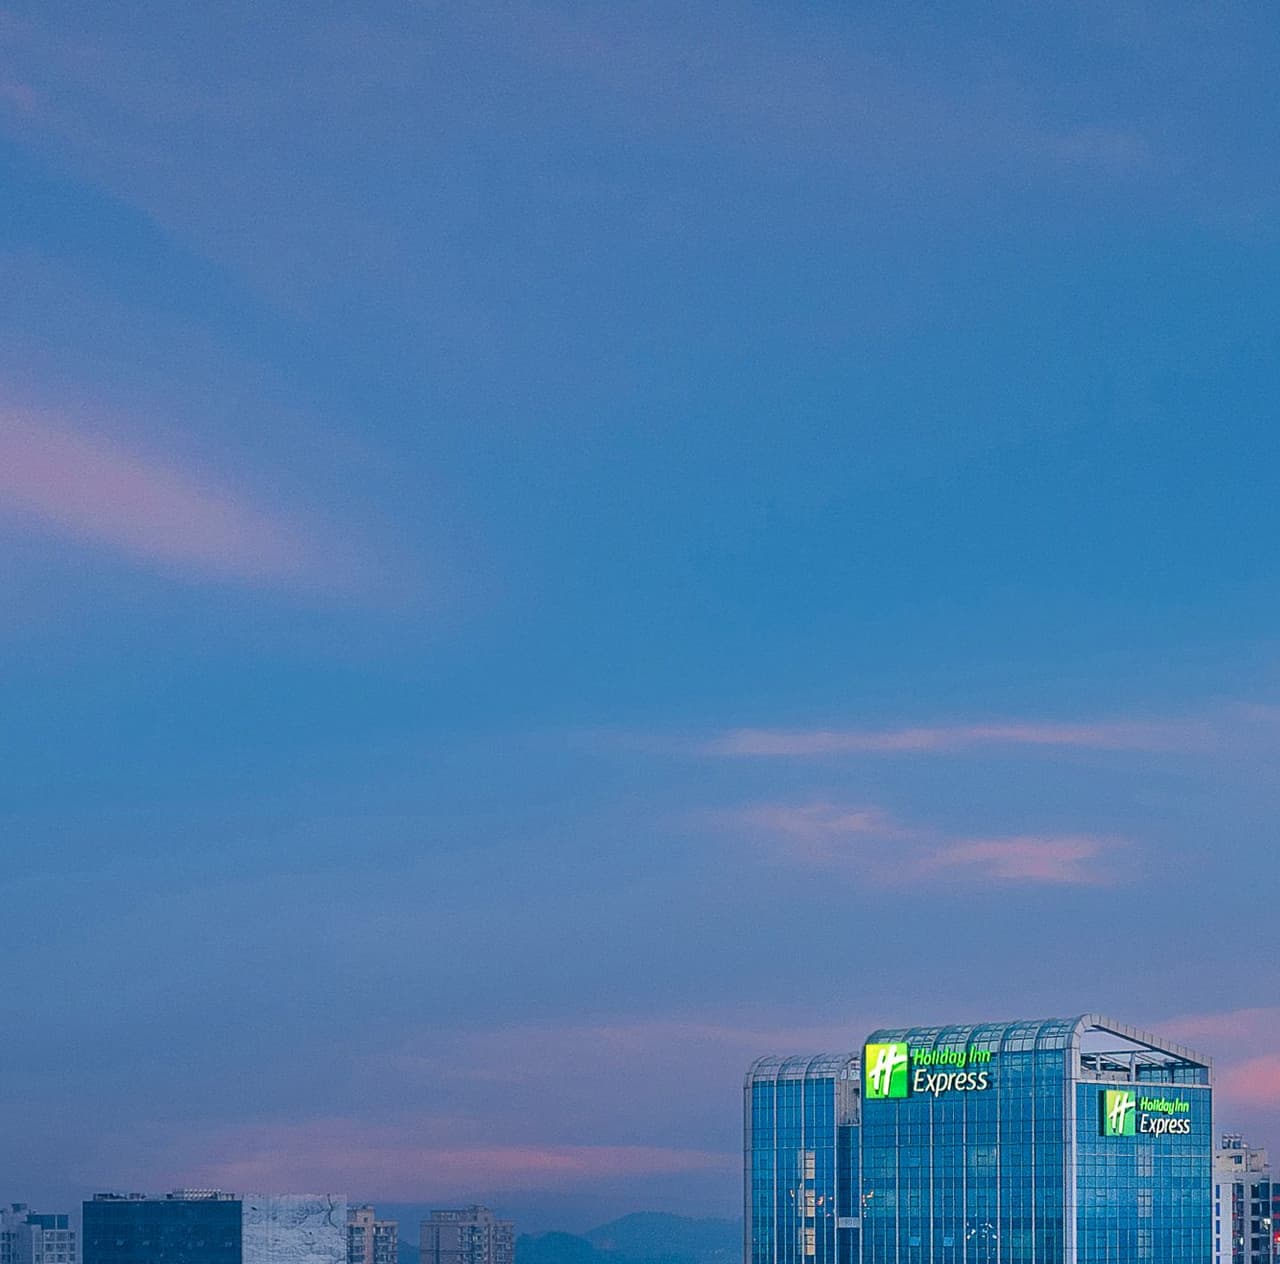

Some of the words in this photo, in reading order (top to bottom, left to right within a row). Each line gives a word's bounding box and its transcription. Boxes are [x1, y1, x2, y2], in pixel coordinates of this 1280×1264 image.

[913, 1047, 966, 1068] Holiday
[969, 1045, 991, 1062] Inn
[913, 1068, 988, 1098] Express
[1140, 1096, 1175, 1115] Holiday
[1175, 1097, 1190, 1112] Inn
[1140, 1113, 1190, 1138] Express
